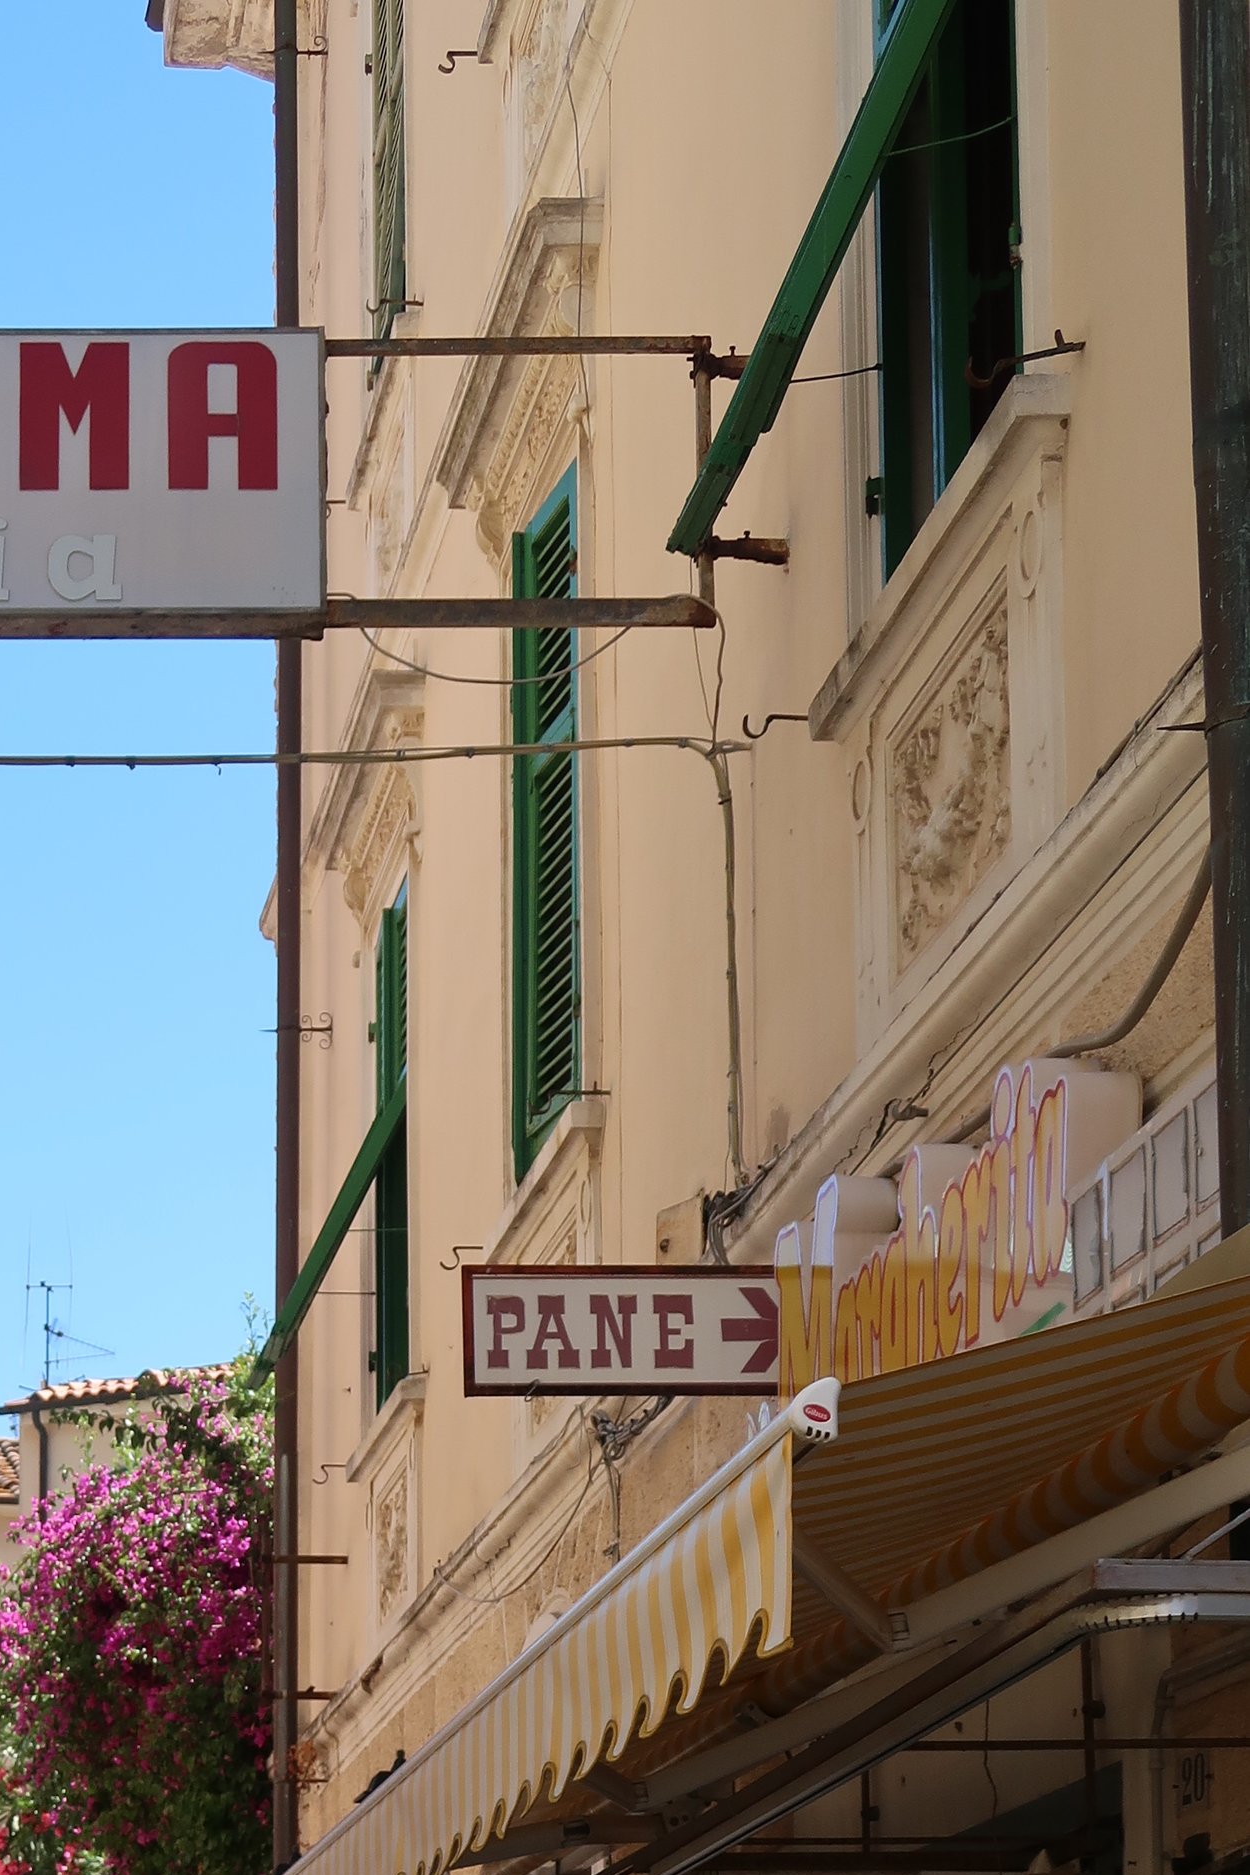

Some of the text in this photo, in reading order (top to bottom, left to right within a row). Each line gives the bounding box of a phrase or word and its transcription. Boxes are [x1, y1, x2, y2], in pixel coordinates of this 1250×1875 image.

[774, 1060, 1068, 1408] Margherita
[485, 1294, 694, 1370] PANE
[1181, 1752, 1205, 1806] 20
